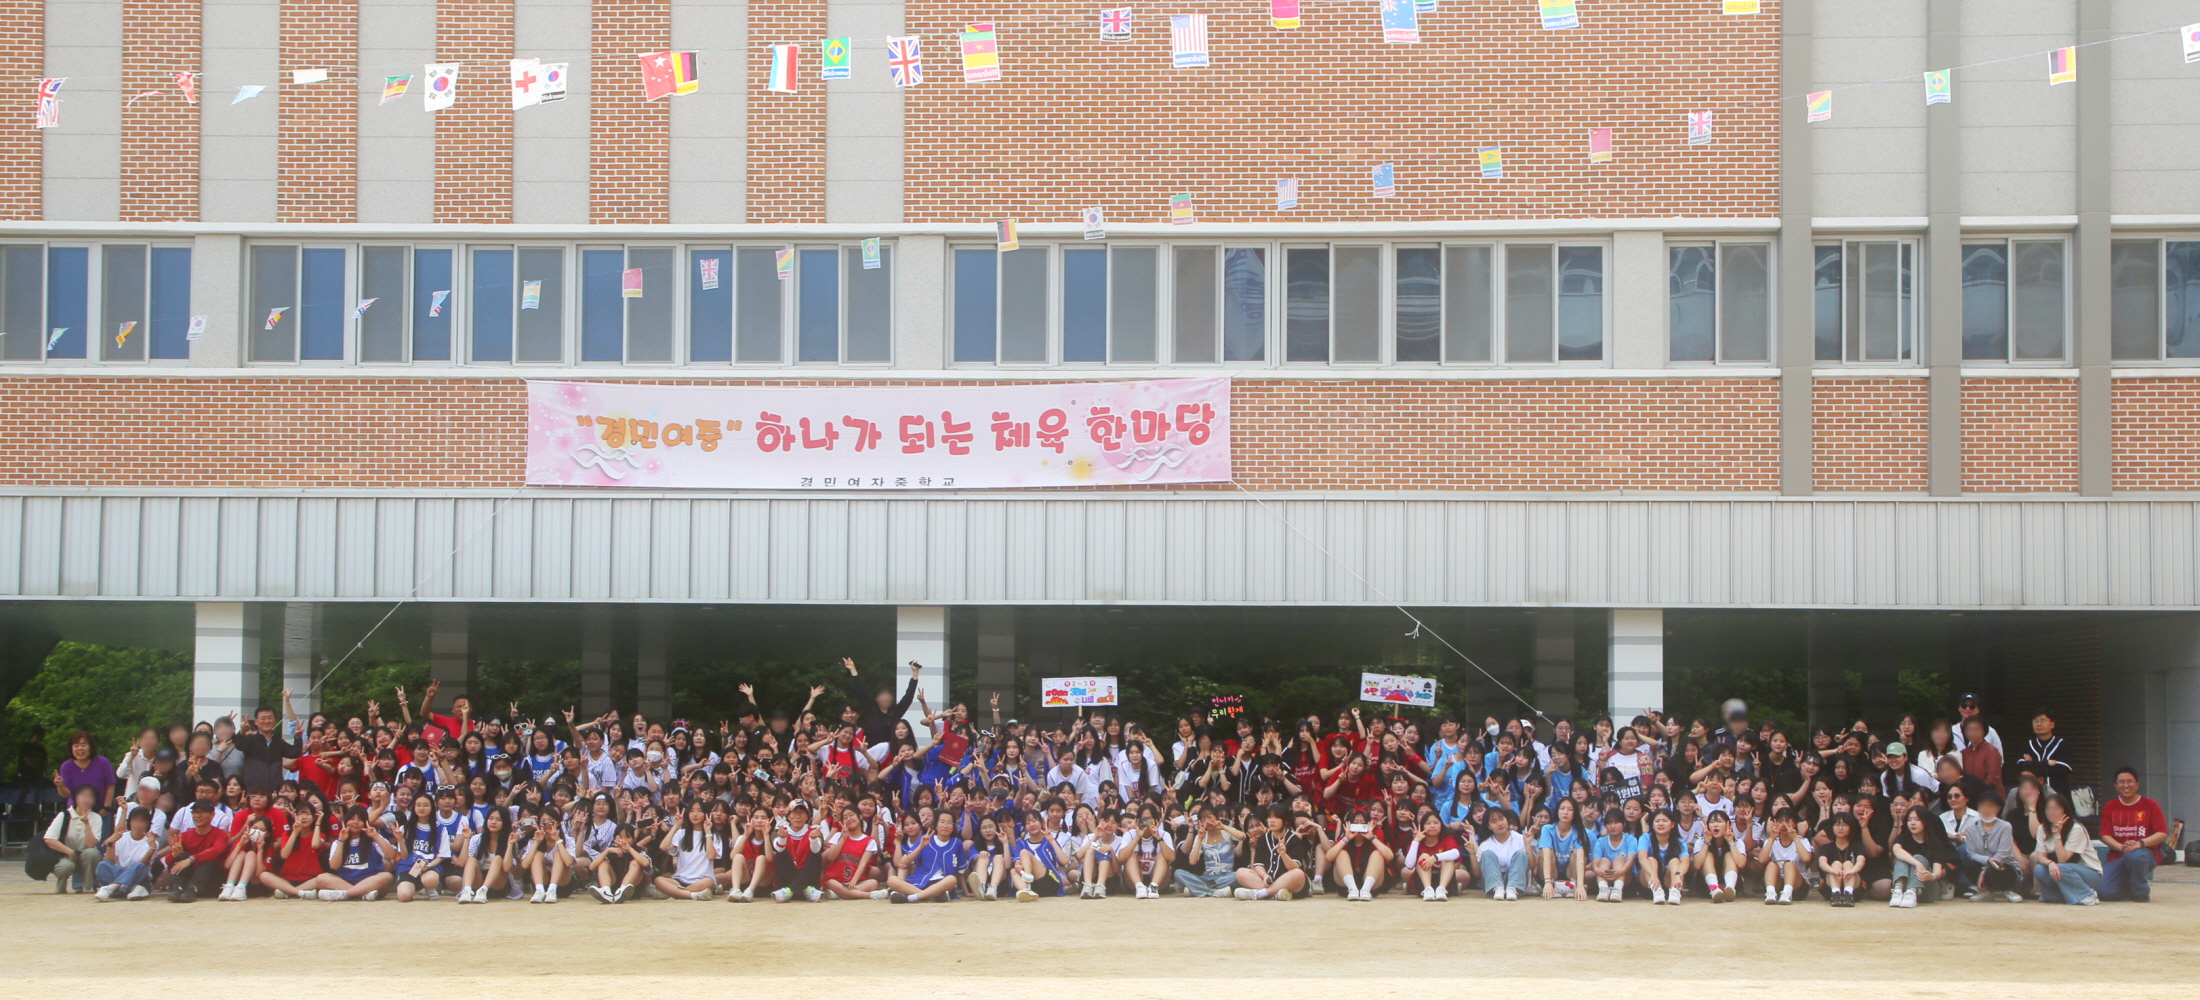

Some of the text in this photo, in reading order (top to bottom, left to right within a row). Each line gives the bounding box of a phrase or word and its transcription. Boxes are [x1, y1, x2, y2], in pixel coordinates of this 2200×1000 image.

[541, 93, 565, 102] Welcome
[755, 411, 882, 453] 하나가
[899, 411, 974, 455] 되는
[990, 408, 1069, 454] 체육
[1086, 403, 1216, 452] 한마당
[844, 866, 852, 878] 5
